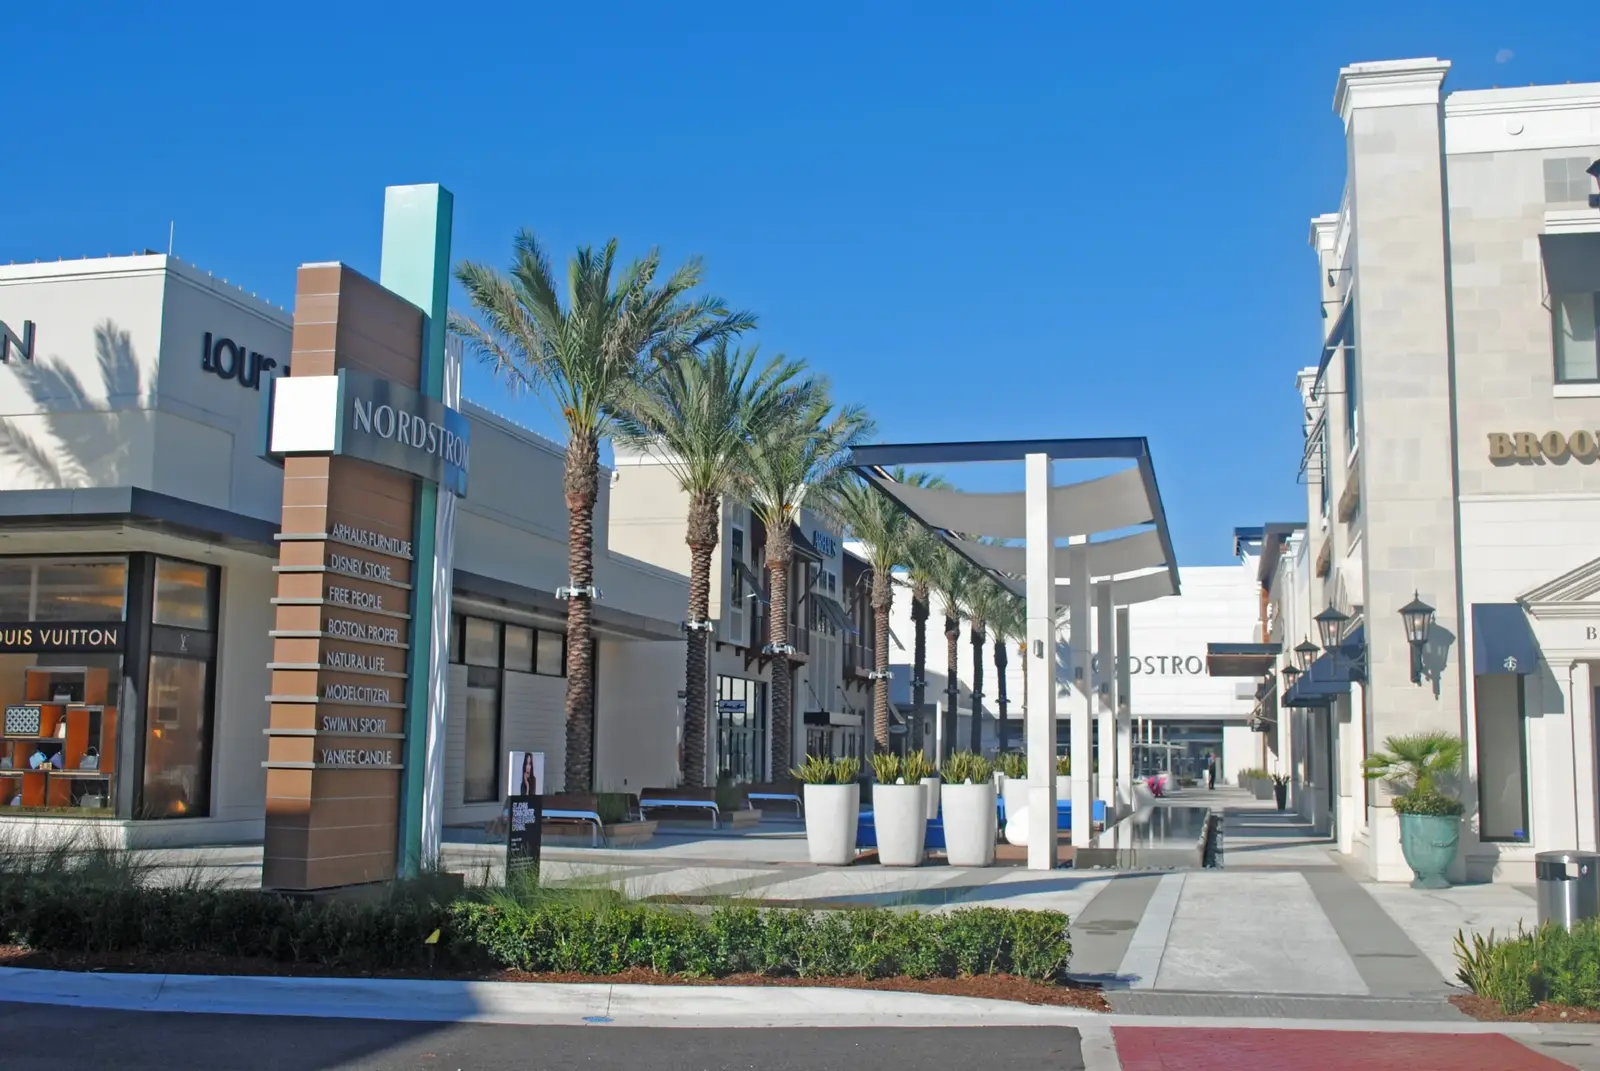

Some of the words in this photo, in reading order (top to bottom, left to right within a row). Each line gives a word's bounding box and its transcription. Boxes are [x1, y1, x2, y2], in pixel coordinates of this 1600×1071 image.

[353, 397, 470, 474] NORDSTROM
[1489, 430, 1600, 459] BROO
[332, 523, 368, 545] ARHAUS
[369, 532, 413, 556] FURNITURE
[331, 554, 363, 574] DISNEY
[365, 561, 392, 581] STORE
[329, 586, 349, 604] FREE
[351, 590, 382, 610] PEOPLE
[0, 629, 32, 646] UIS
[39, 629, 118, 646] VUITTON
[328, 618, 366, 639] BOSTON
[368, 625, 399, 644] PROPER
[326, 651, 368, 670] NATURAL
[368, 656, 385, 672] LIFE
[1092, 655, 1208, 675] DSTRO
[360, 718, 387, 734] SPORT
[321, 747, 356, 765] YANKEE
[358, 749, 392, 765] CANDLE
